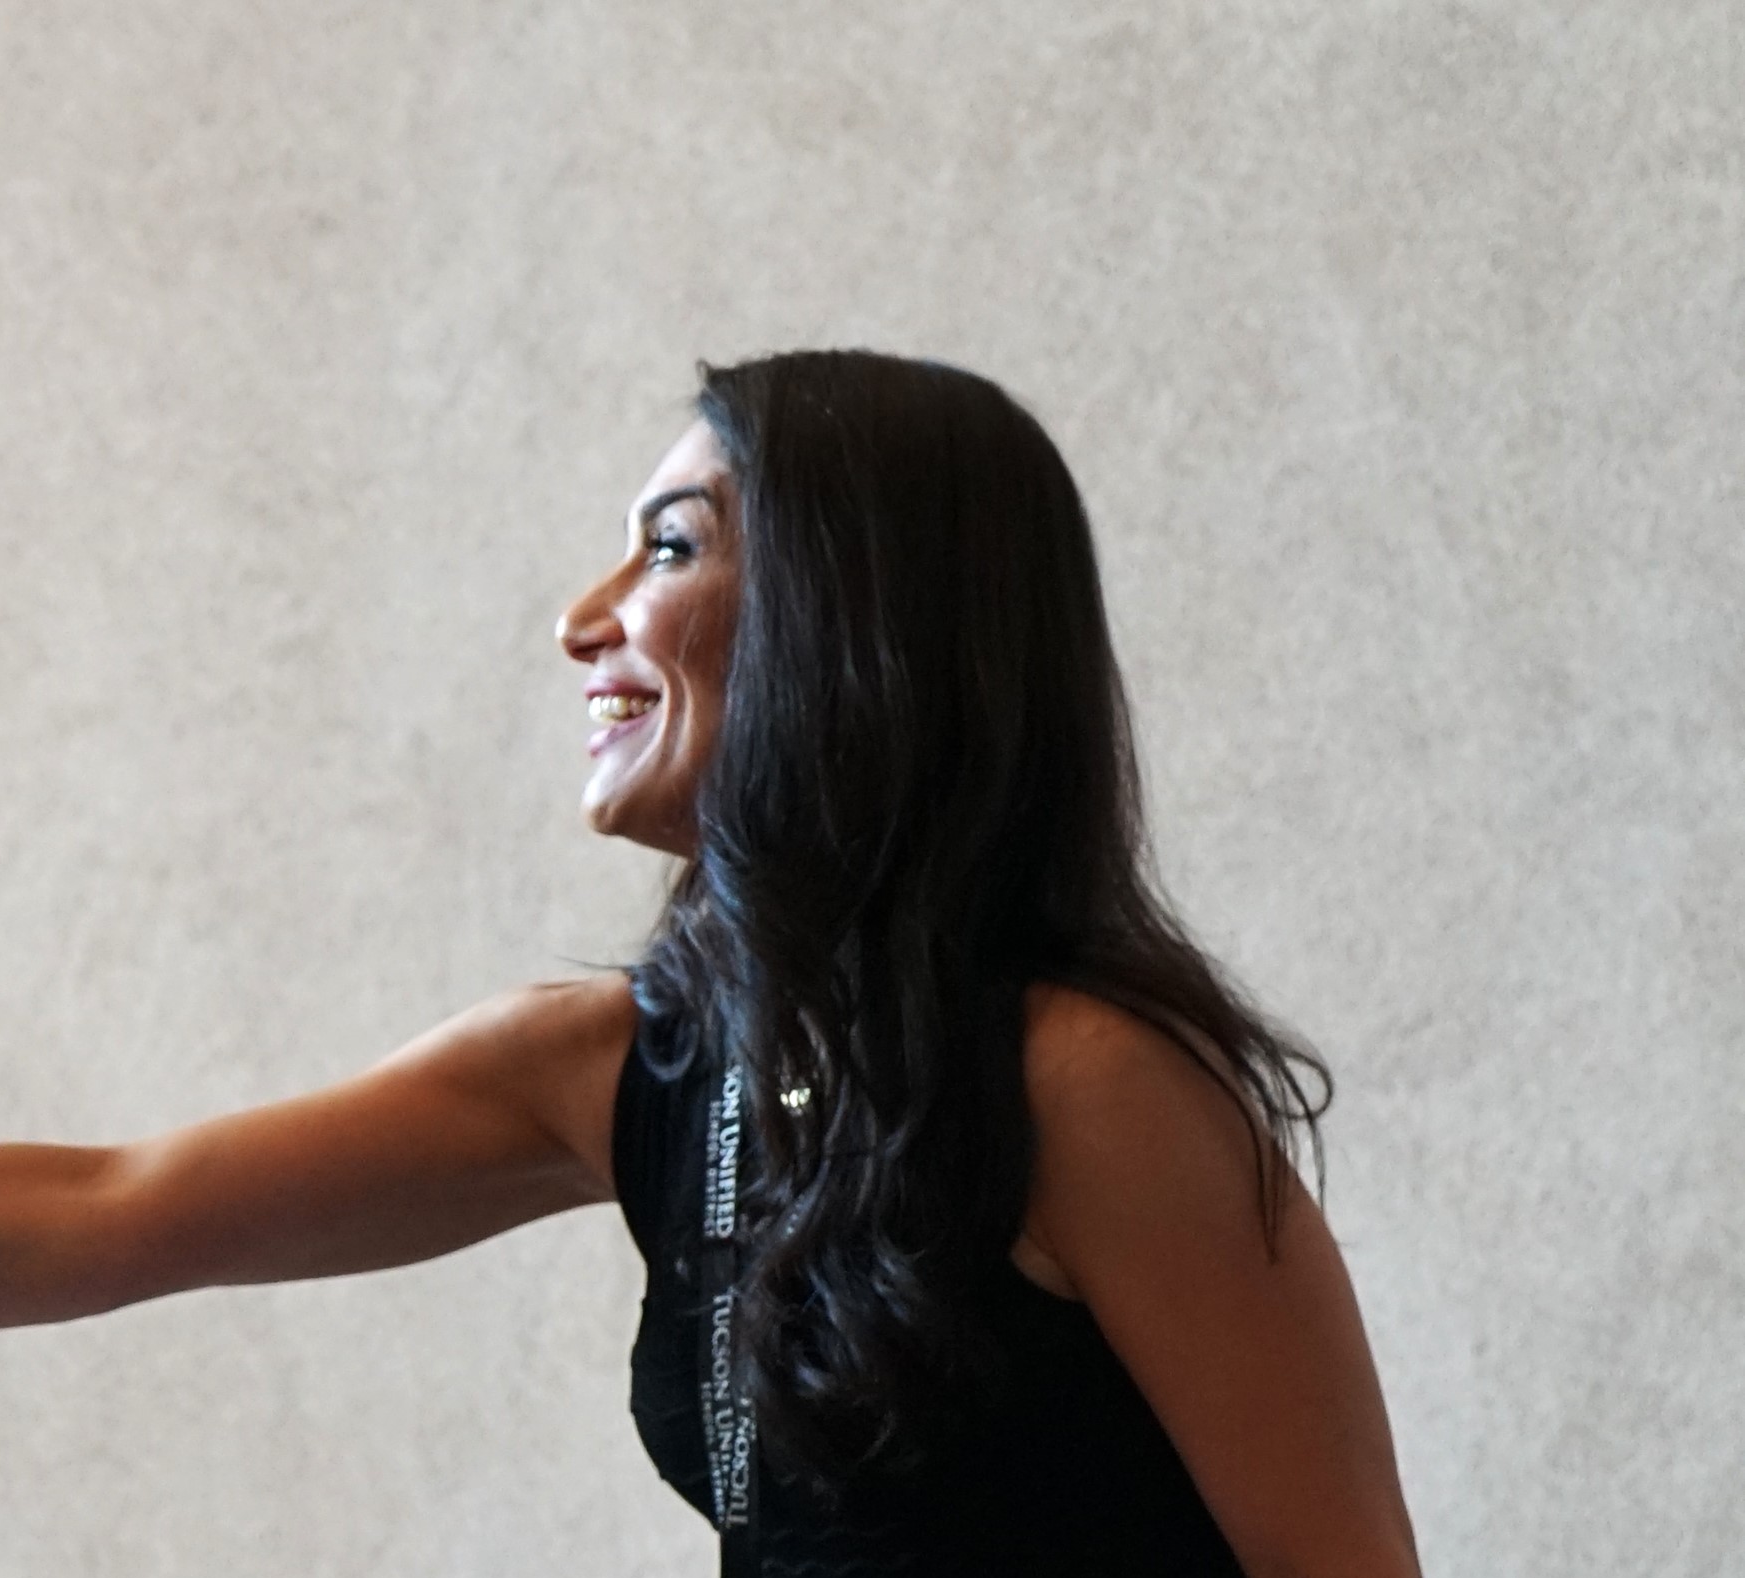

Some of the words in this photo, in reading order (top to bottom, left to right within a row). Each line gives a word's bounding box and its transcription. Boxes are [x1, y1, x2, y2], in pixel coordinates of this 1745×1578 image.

[722, 1064, 742, 1120] SON
[716, 1123, 741, 1239] UNIFIED
[711, 1293, 733, 1401] TUCSON
